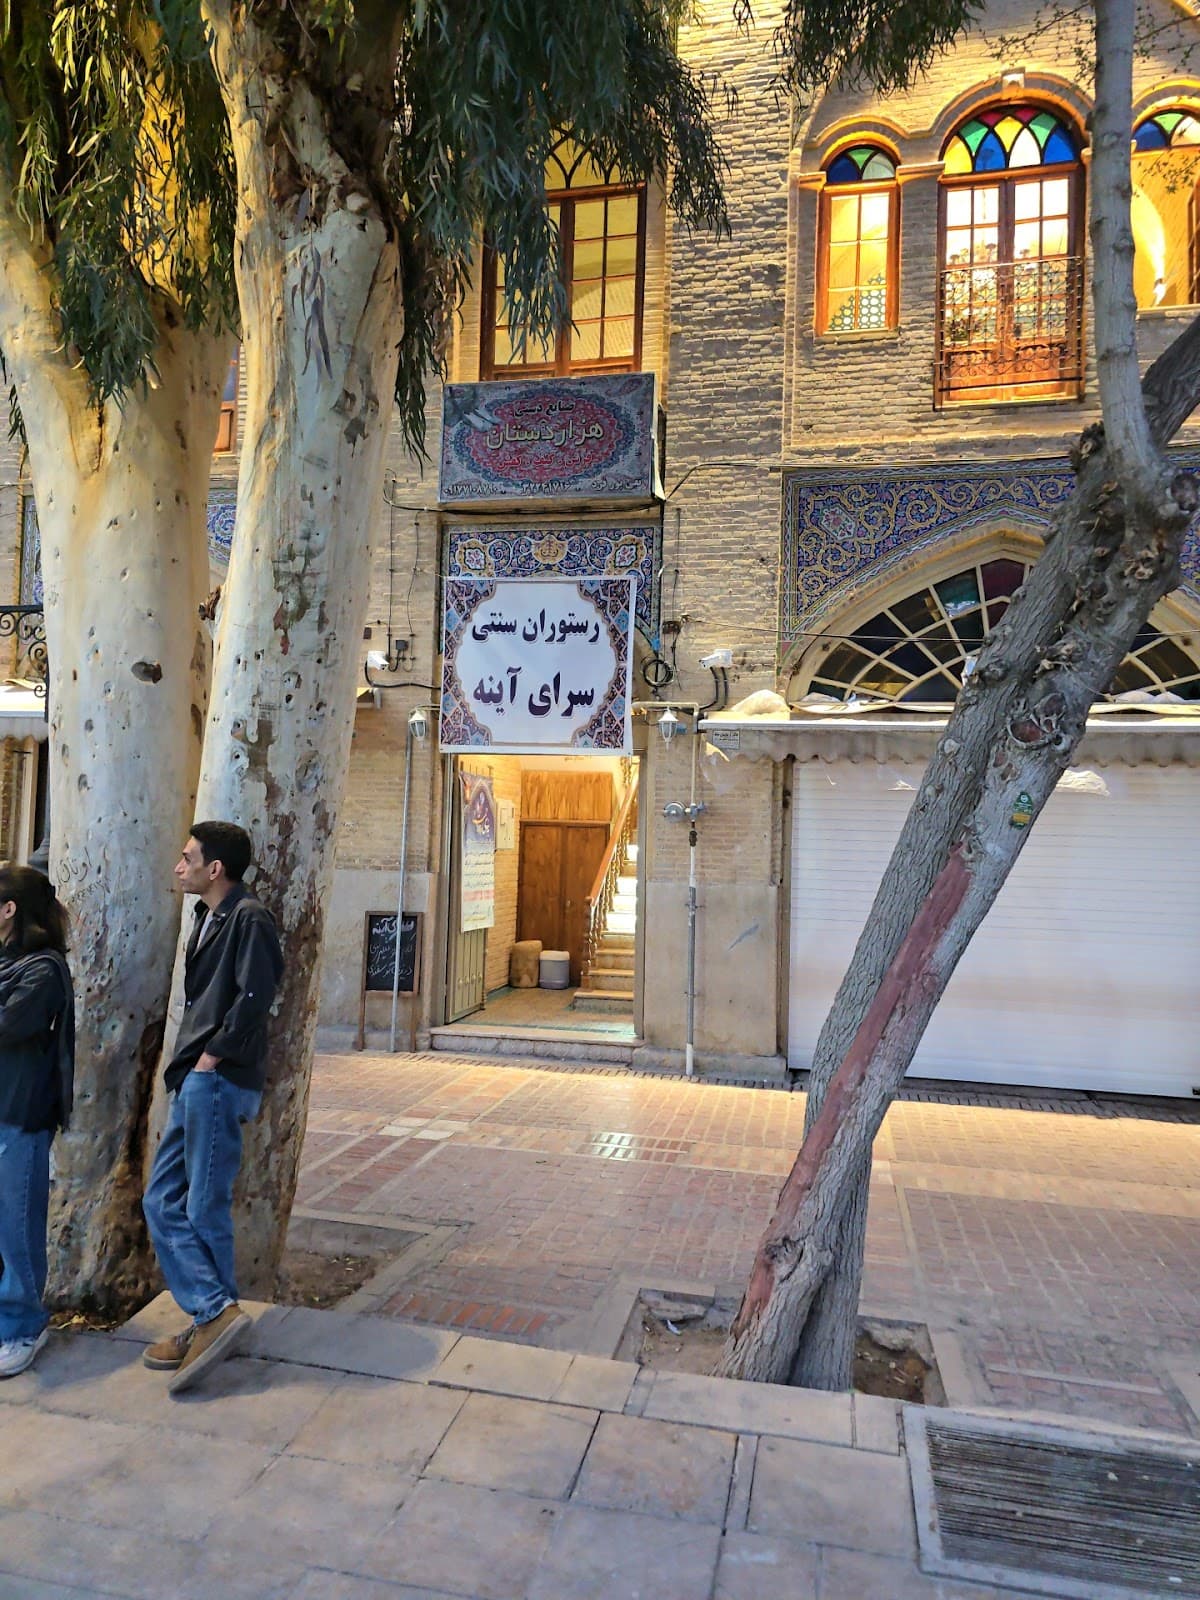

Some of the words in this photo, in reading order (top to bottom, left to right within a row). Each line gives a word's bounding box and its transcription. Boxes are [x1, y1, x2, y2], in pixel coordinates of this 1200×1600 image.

[514, 402, 543, 418] دستی
[546, 400, 575, 416] صنایع
[486, 420, 554, 449] دستان
[555, 419, 604, 447] هزار
[498, 454, 523, 470] کفش
[563, 452, 594, 469] فرش
[471, 612, 518, 642] سنتی
[522, 608, 600, 643] رستوران
[472, 666, 523, 714] آینه
[528, 671, 595, 717] سرای
